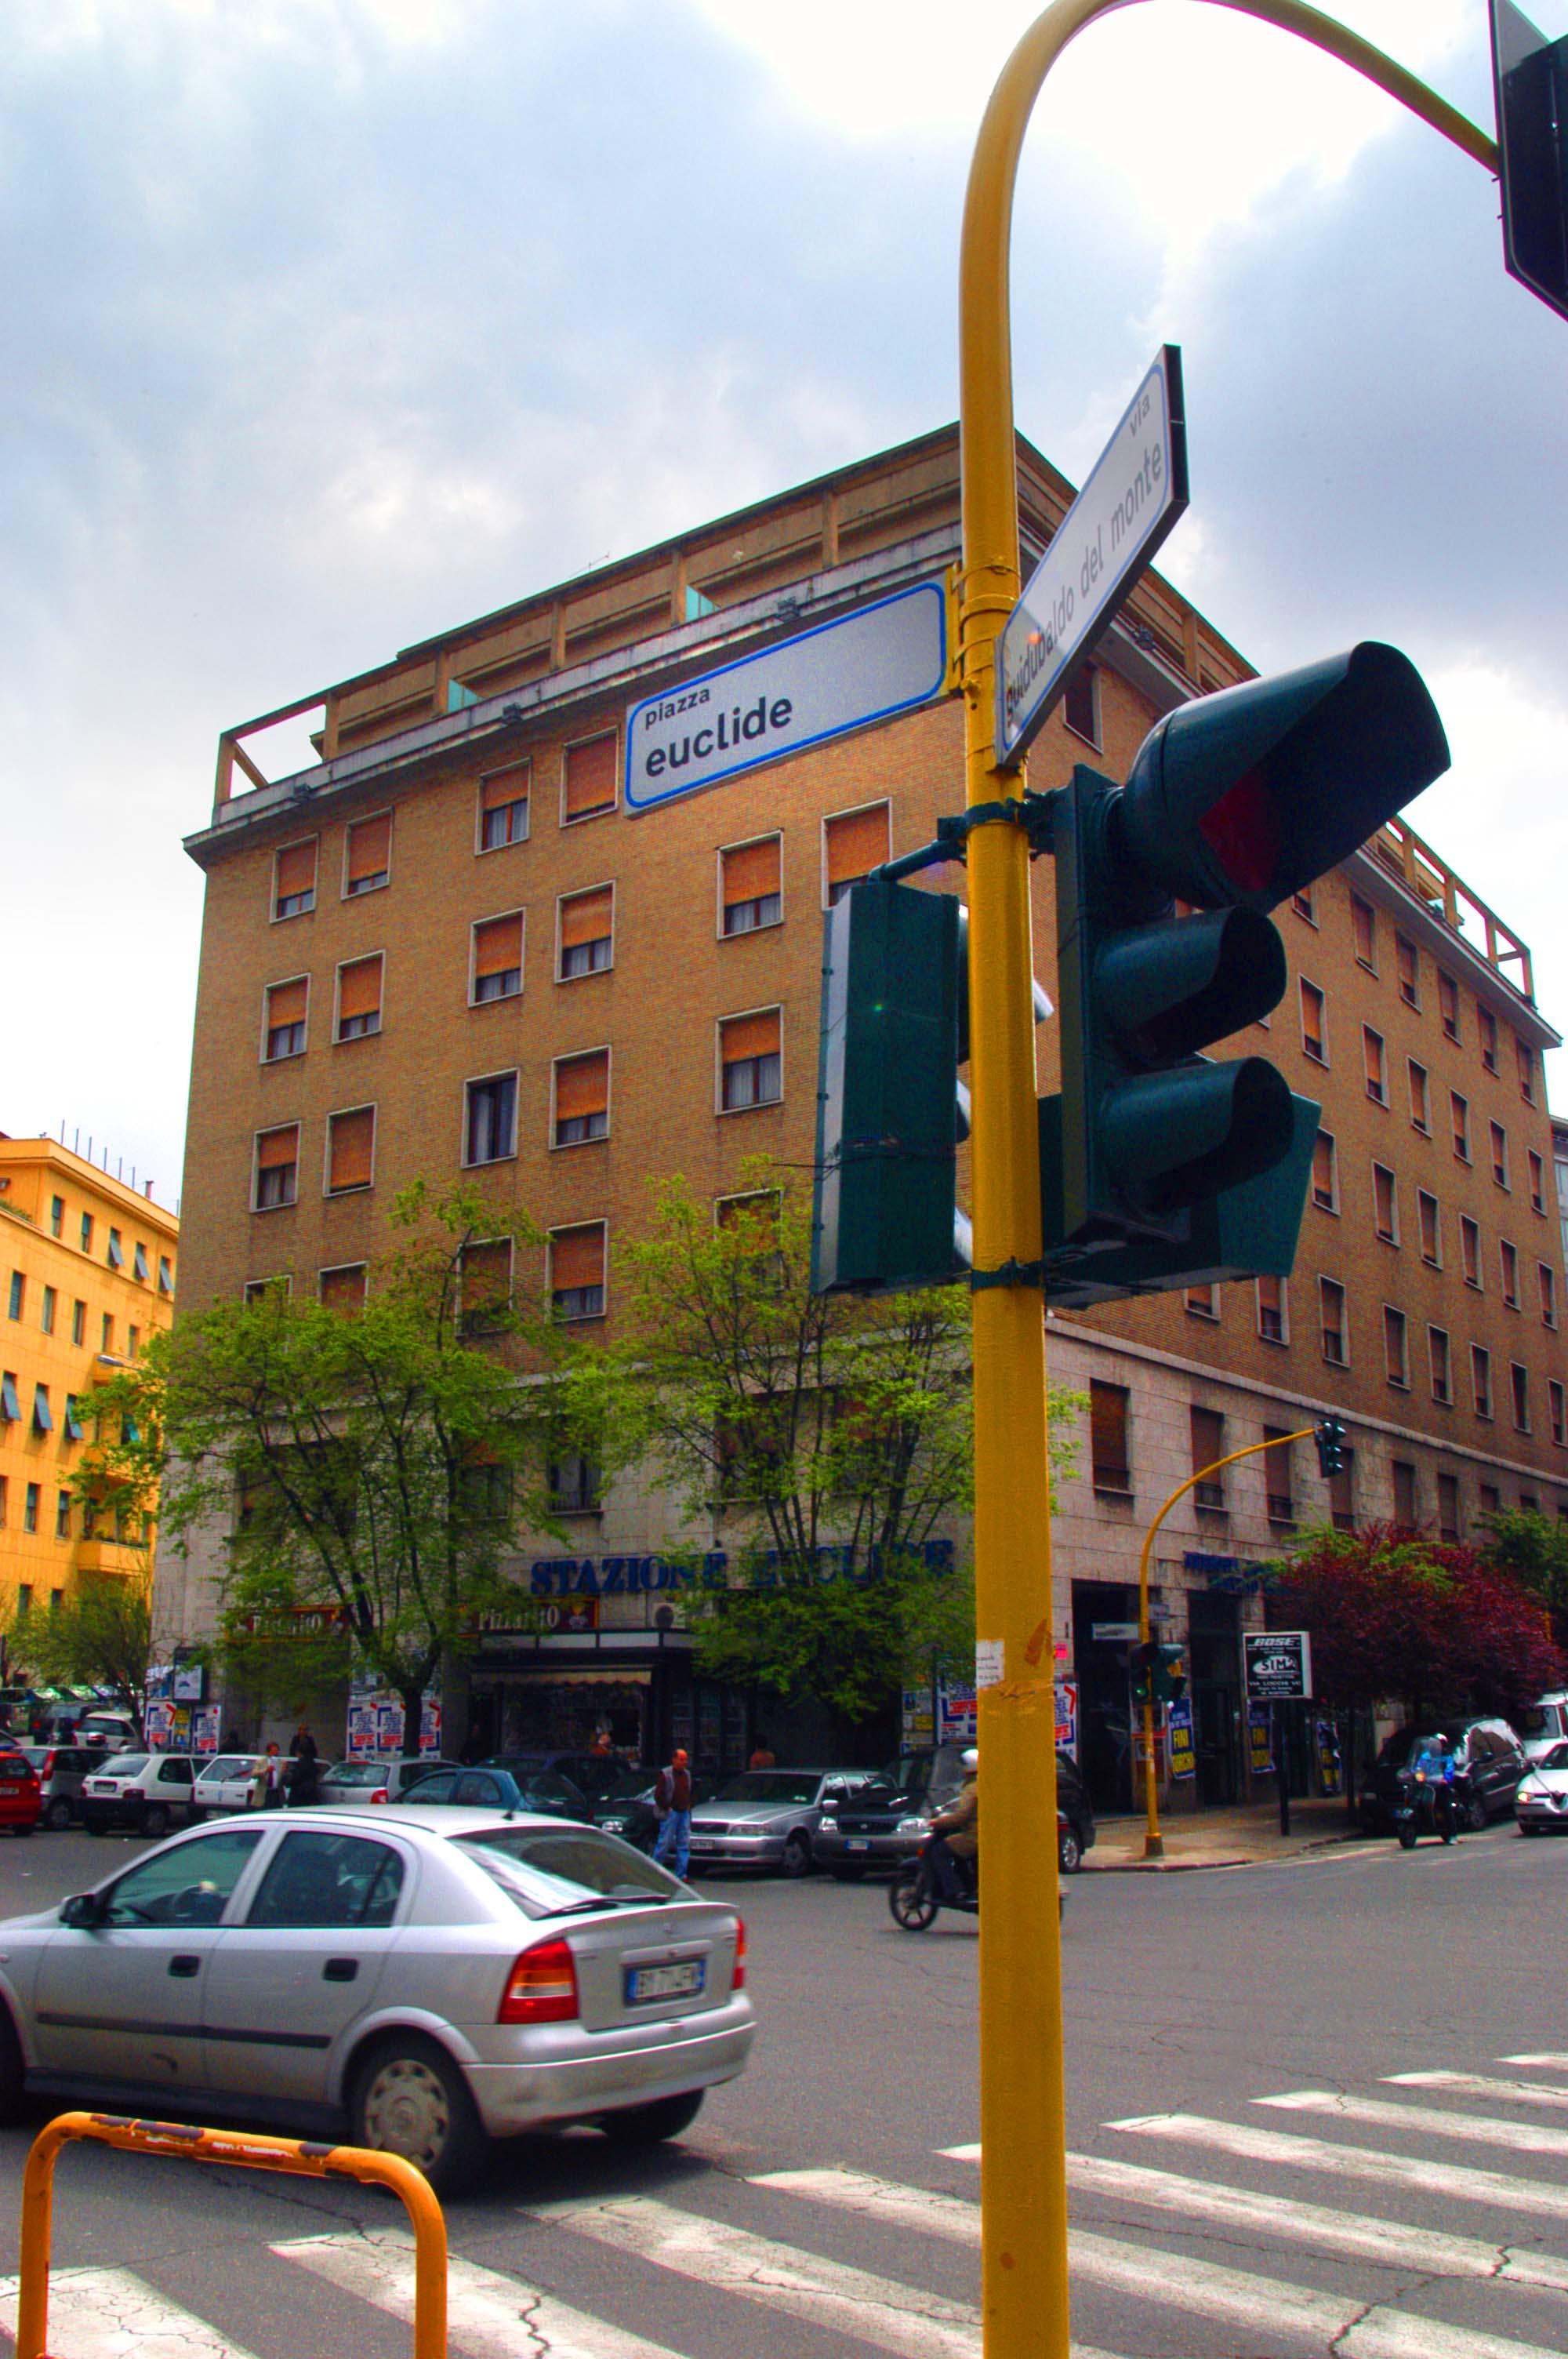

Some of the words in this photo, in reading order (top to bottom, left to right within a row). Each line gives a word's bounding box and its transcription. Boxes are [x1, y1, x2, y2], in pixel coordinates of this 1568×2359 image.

[1129, 394, 1151, 439] via
[1080, 524, 1104, 599] del
[1110, 442, 1162, 552] monte
[644, 687, 711, 730] piazza
[645, 696, 793, 778] euclide
[530, 1552, 728, 1595] STAZIONE
[1254, 1636, 1300, 1647] BOSE
